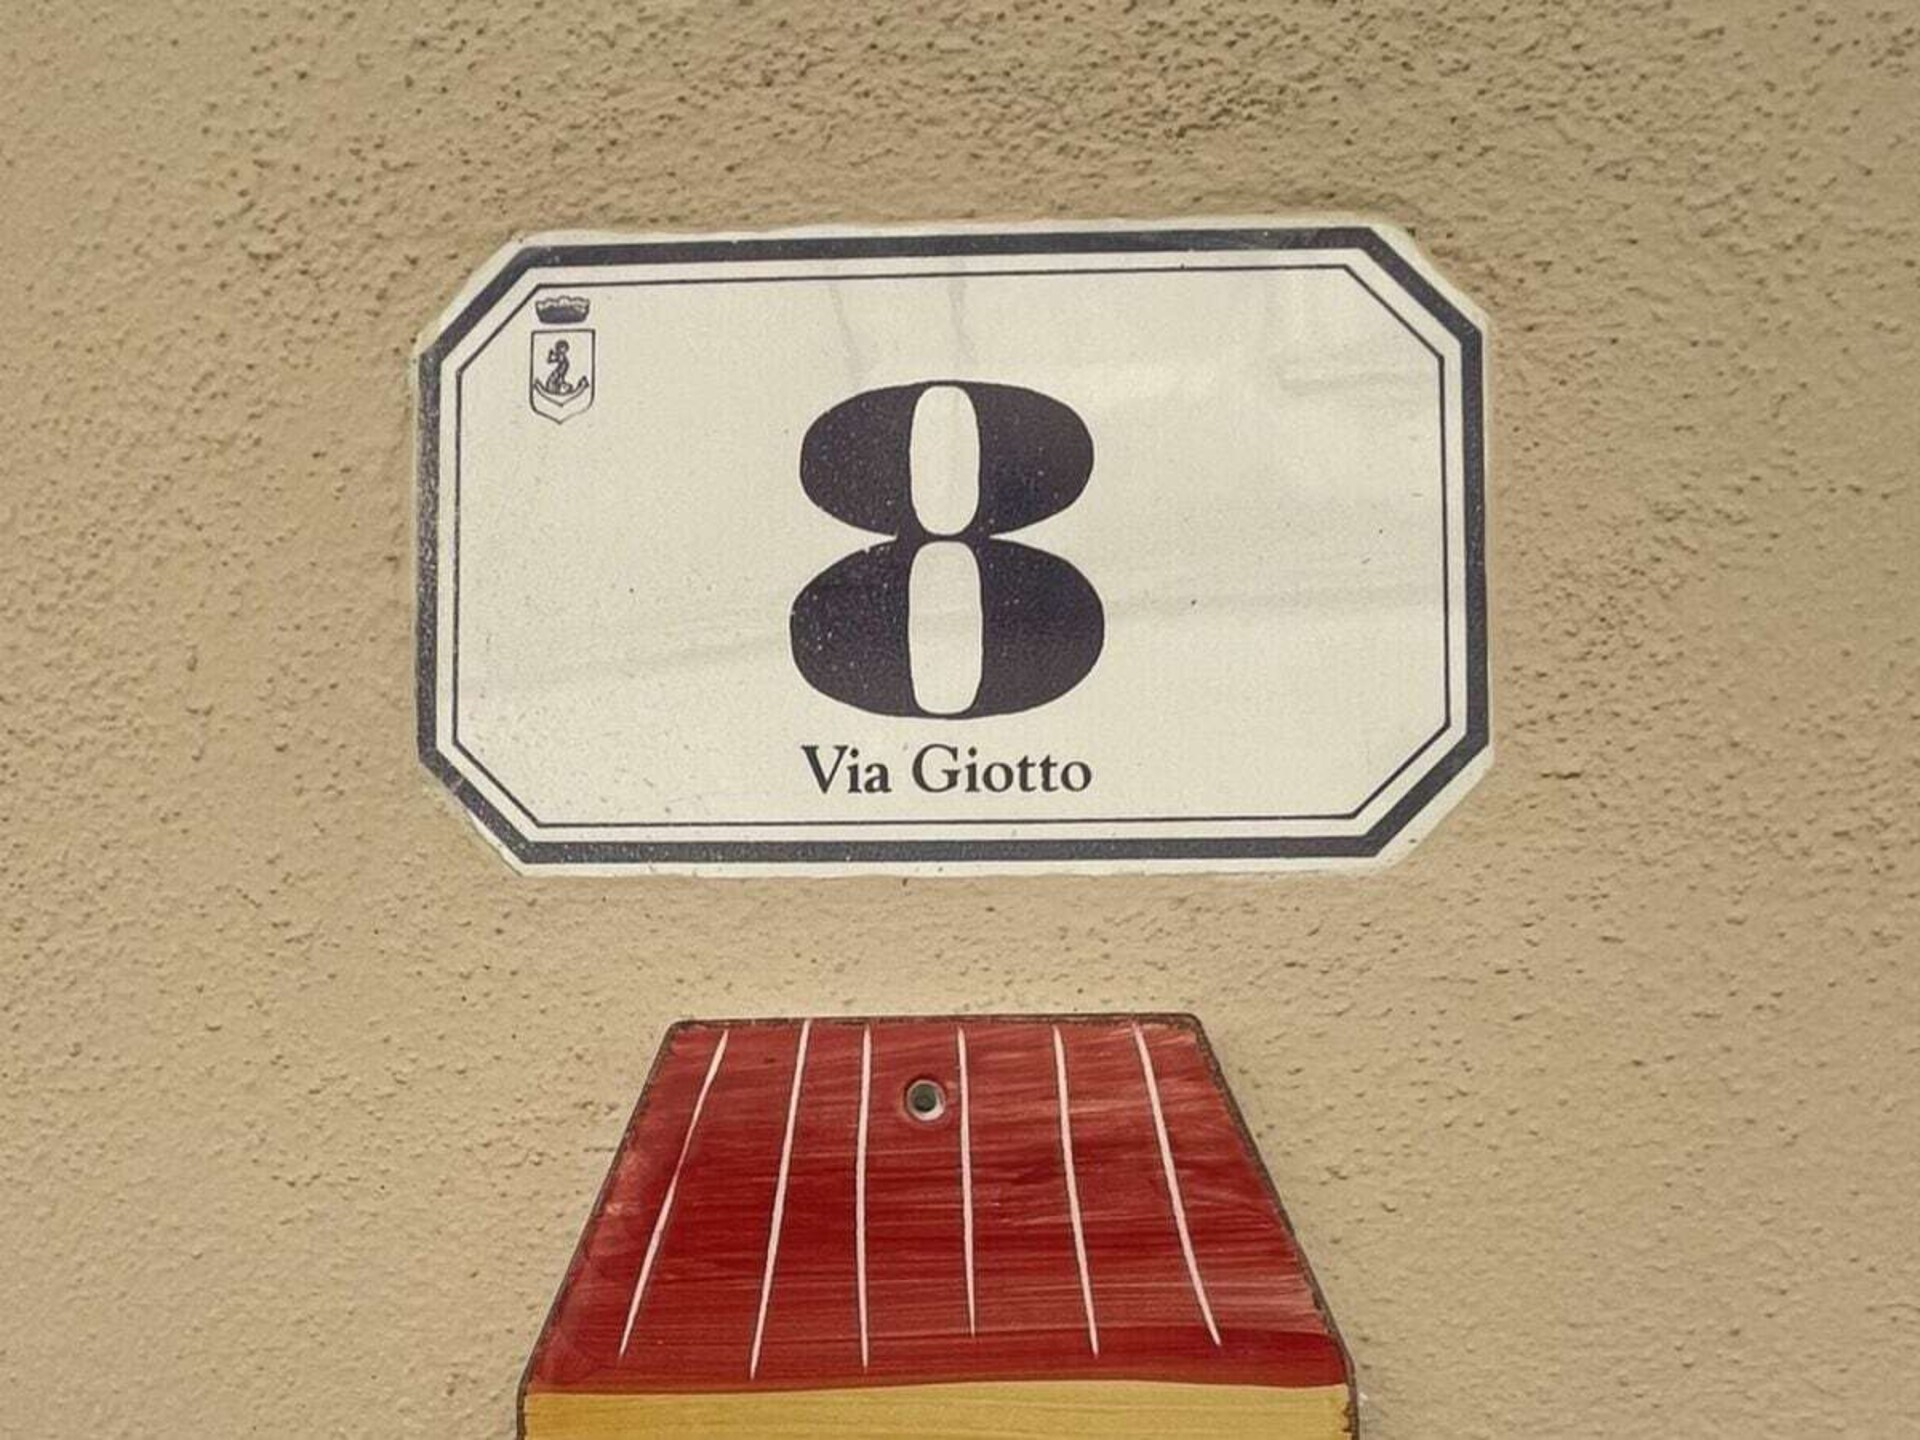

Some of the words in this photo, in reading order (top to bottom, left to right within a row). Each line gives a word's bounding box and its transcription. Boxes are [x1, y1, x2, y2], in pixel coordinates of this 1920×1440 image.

[790, 380, 1104, 720] 8
[801, 744, 892, 794] Via
[912, 743, 1092, 794] Giotto
